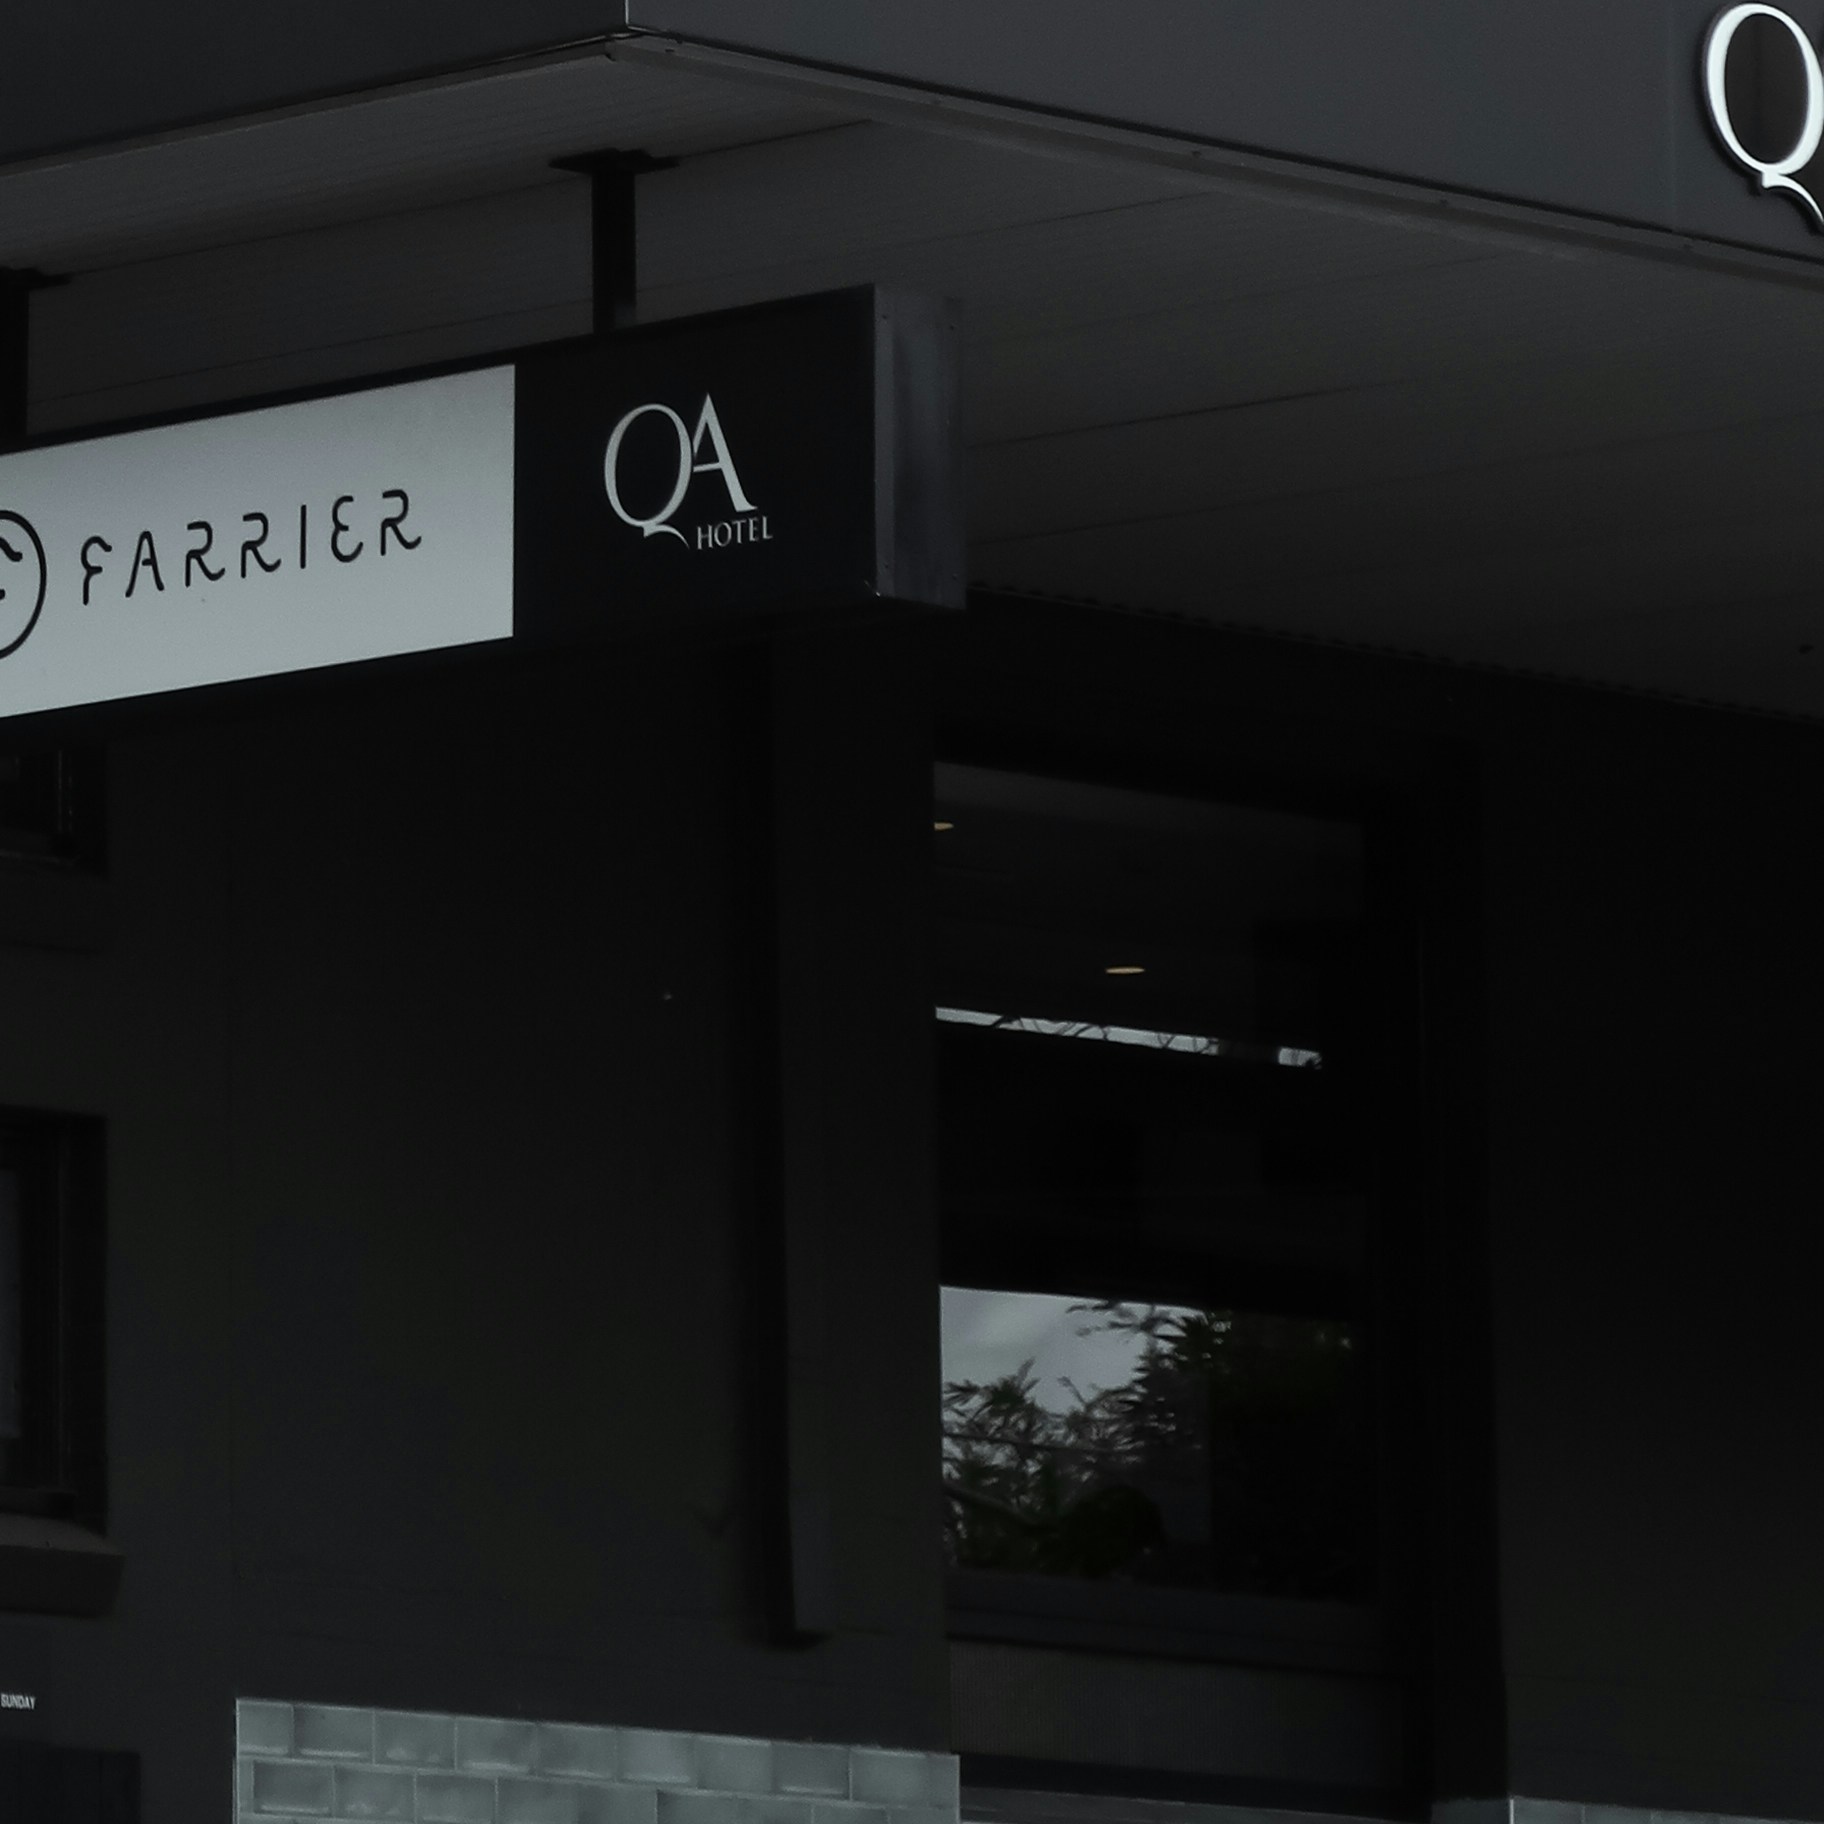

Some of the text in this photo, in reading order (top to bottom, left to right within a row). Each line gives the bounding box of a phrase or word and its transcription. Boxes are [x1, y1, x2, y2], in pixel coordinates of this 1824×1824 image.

[604, 393, 758, 549] QA
[80, 489, 422, 606] FARRIER
[697, 516, 773, 550] HOTEL
[1, 1693, 35, 1709] SUNDAY
